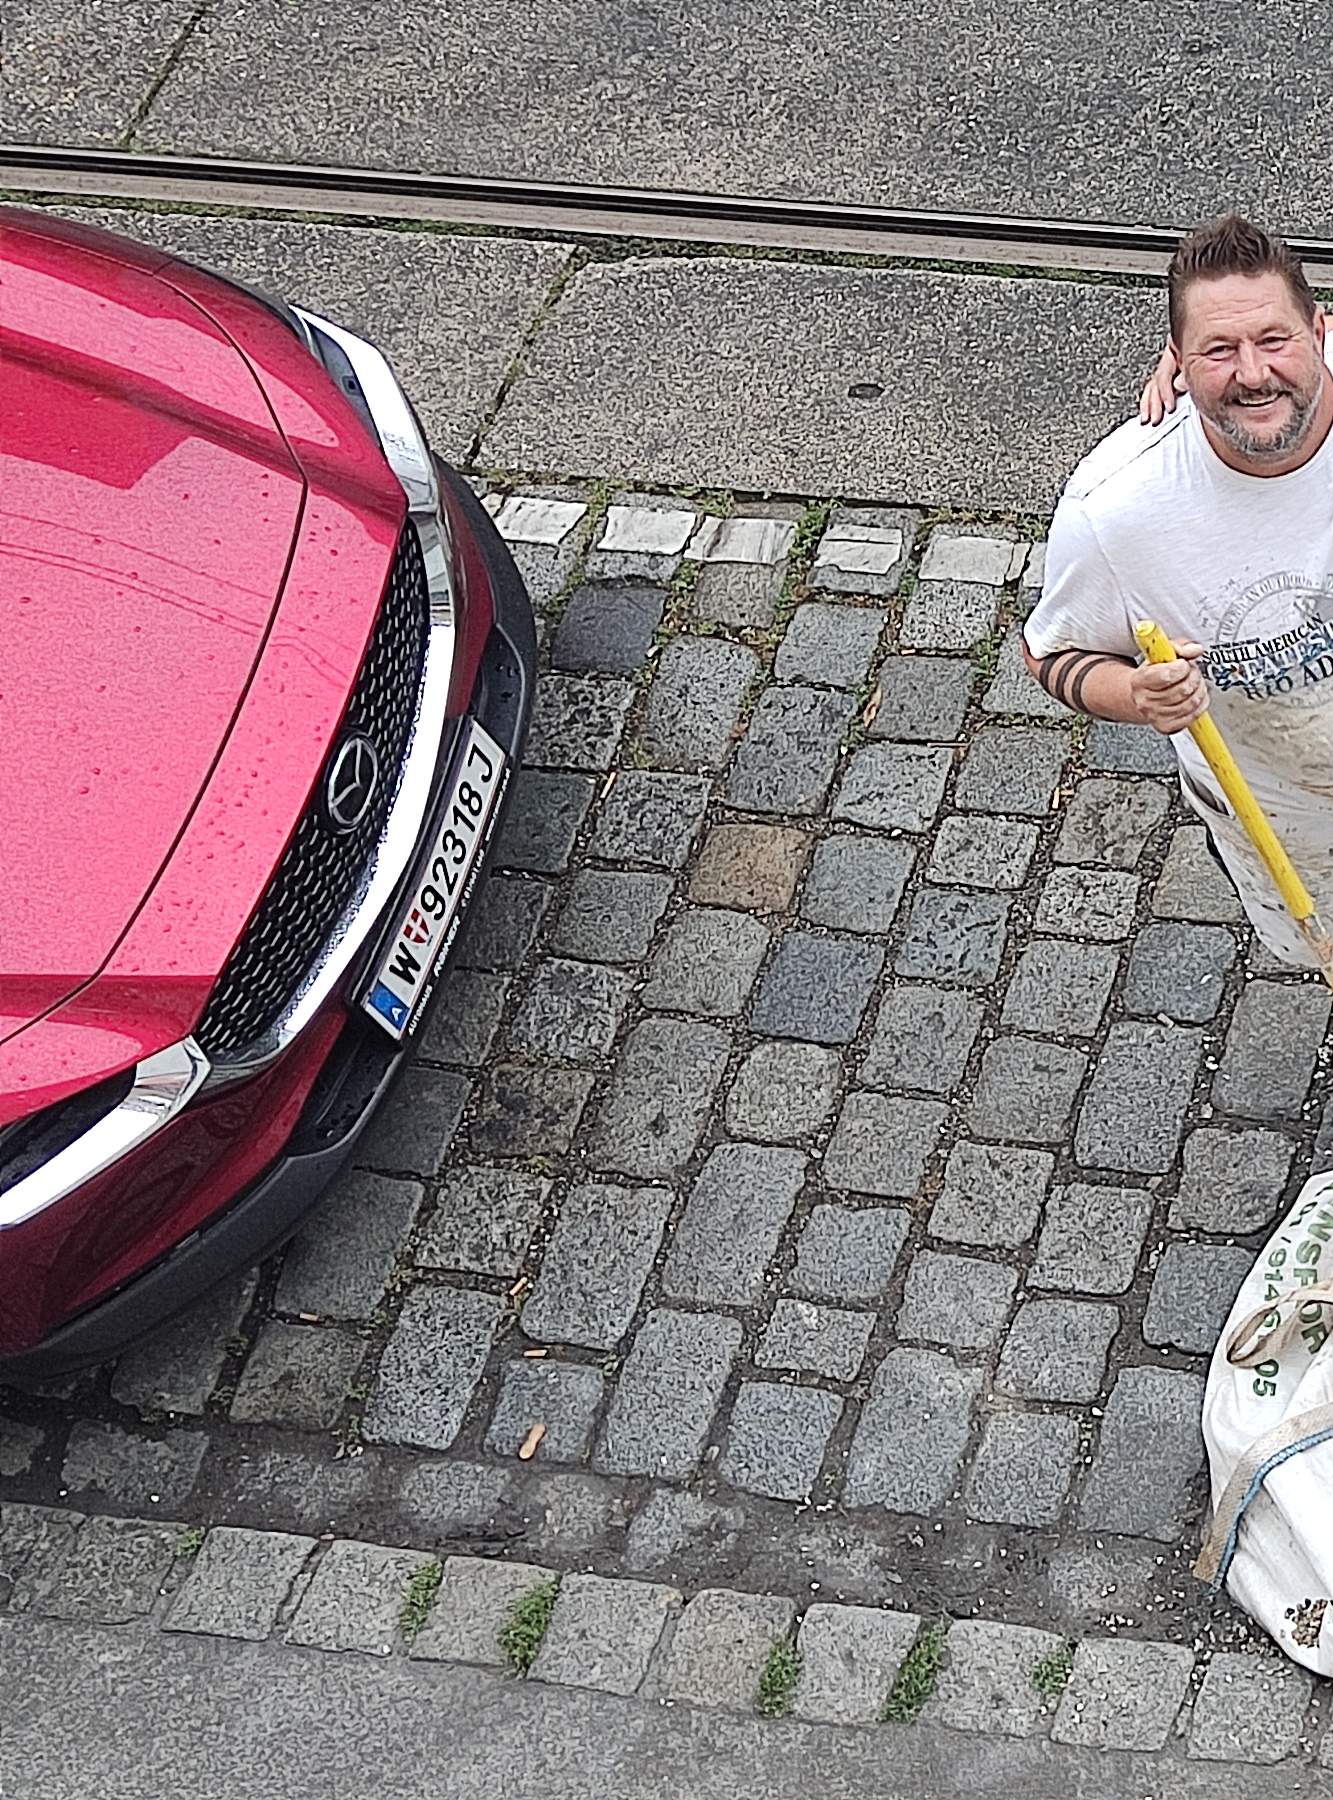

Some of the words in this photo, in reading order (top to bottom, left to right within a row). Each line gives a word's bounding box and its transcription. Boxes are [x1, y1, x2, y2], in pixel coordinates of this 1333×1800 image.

[388, 941, 422, 985] W
[390, 1006, 403, 1022] A
[408, 984, 434, 1036] AUTOHAUS
